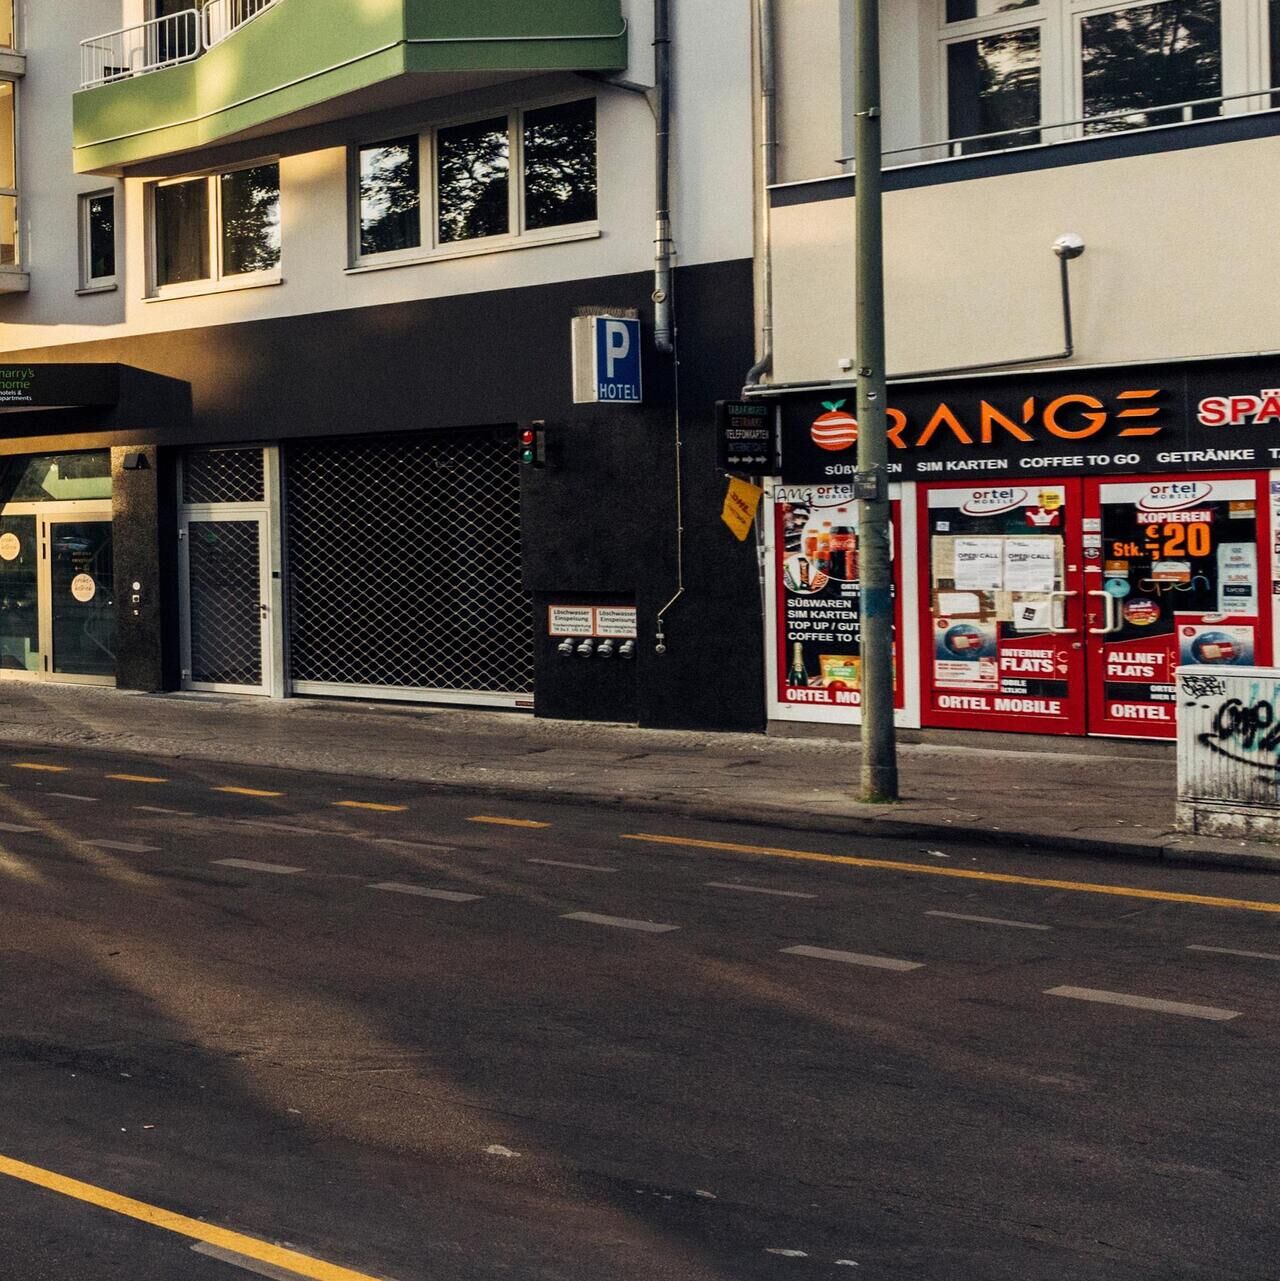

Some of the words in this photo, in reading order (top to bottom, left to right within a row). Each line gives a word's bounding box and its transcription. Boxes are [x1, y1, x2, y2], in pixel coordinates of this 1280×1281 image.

[606, 321, 630, 378] P
[600, 383, 638, 399] HOTEL
[916, 462, 944, 471] SIM
[946, 459, 1008, 470] KARTEN
[1019, 456, 1083, 468] COFFEE
[1087, 455, 1110, 465] TO
[1113, 454, 1140, 465] GO
[1156, 448, 1256, 463] GETRÄNKE
[817, 485, 854, 495] ortel
[972, 489, 1014, 499] ortel
[1150, 483, 1197, 494] ortel
[1137, 511, 1211, 523] KOPIEREN
[1113, 542, 1144, 557] Stk.
[787, 598, 851, 608] SÜßWAREN
[787, 610, 808, 619] SIM
[810, 611, 857, 619] KARTEN
[788, 621, 811, 630] TOP
[813, 621, 829, 630] UP
[788, 632, 833, 641] COFFEE
[836, 633, 852, 642] TO
[1000, 648, 1054, 659] INTERNET
[1108, 651, 1165, 664] ALLNET
[1000, 658, 1054, 673] FLATS
[1107, 666, 1155, 677] FLATS
[786, 689, 833, 703] ORTEL
[938, 695, 990, 710] ORTEL
[994, 698, 1061, 714] MOBILE
[1111, 704, 1171, 720] ORTEL
